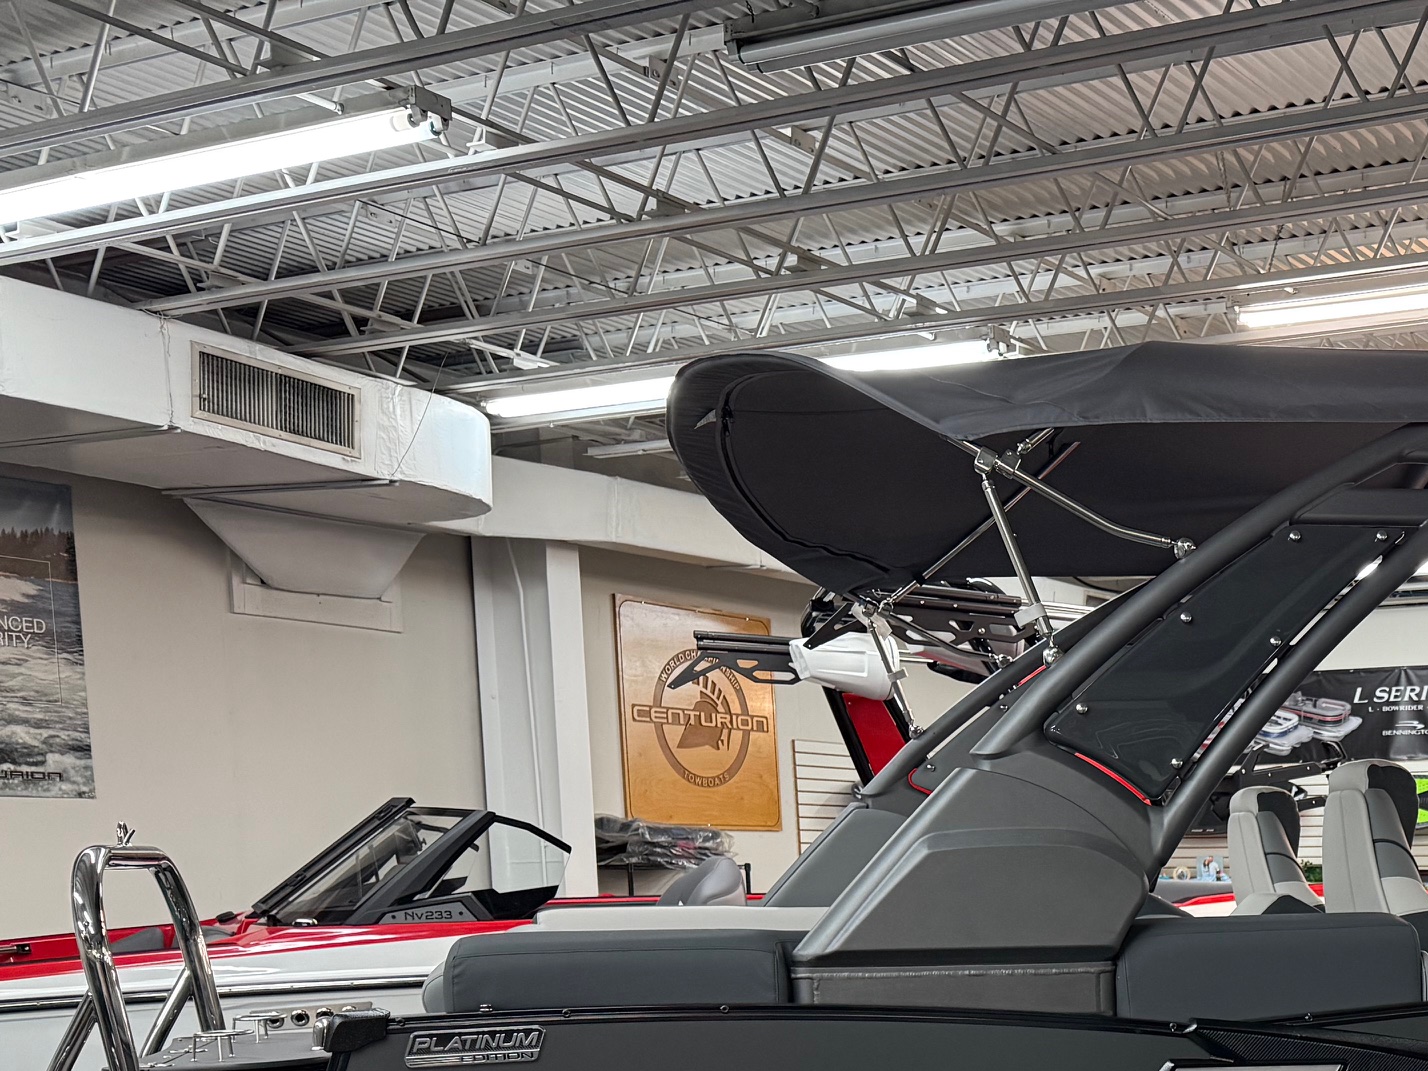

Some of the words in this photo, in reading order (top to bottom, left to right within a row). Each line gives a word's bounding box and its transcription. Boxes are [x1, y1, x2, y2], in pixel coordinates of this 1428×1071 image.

[660, 653, 685, 682] WORLD
[1353, 687, 1369, 704] L
[1382, 704, 1424, 712] BOWRIDER
[633, 706, 768, 732] CENTURION
[683, 769, 729, 787] TOWBOATS
[412, 1031, 539, 1052] PLATINUM
[460, 1052, 535, 1063] EDITION
